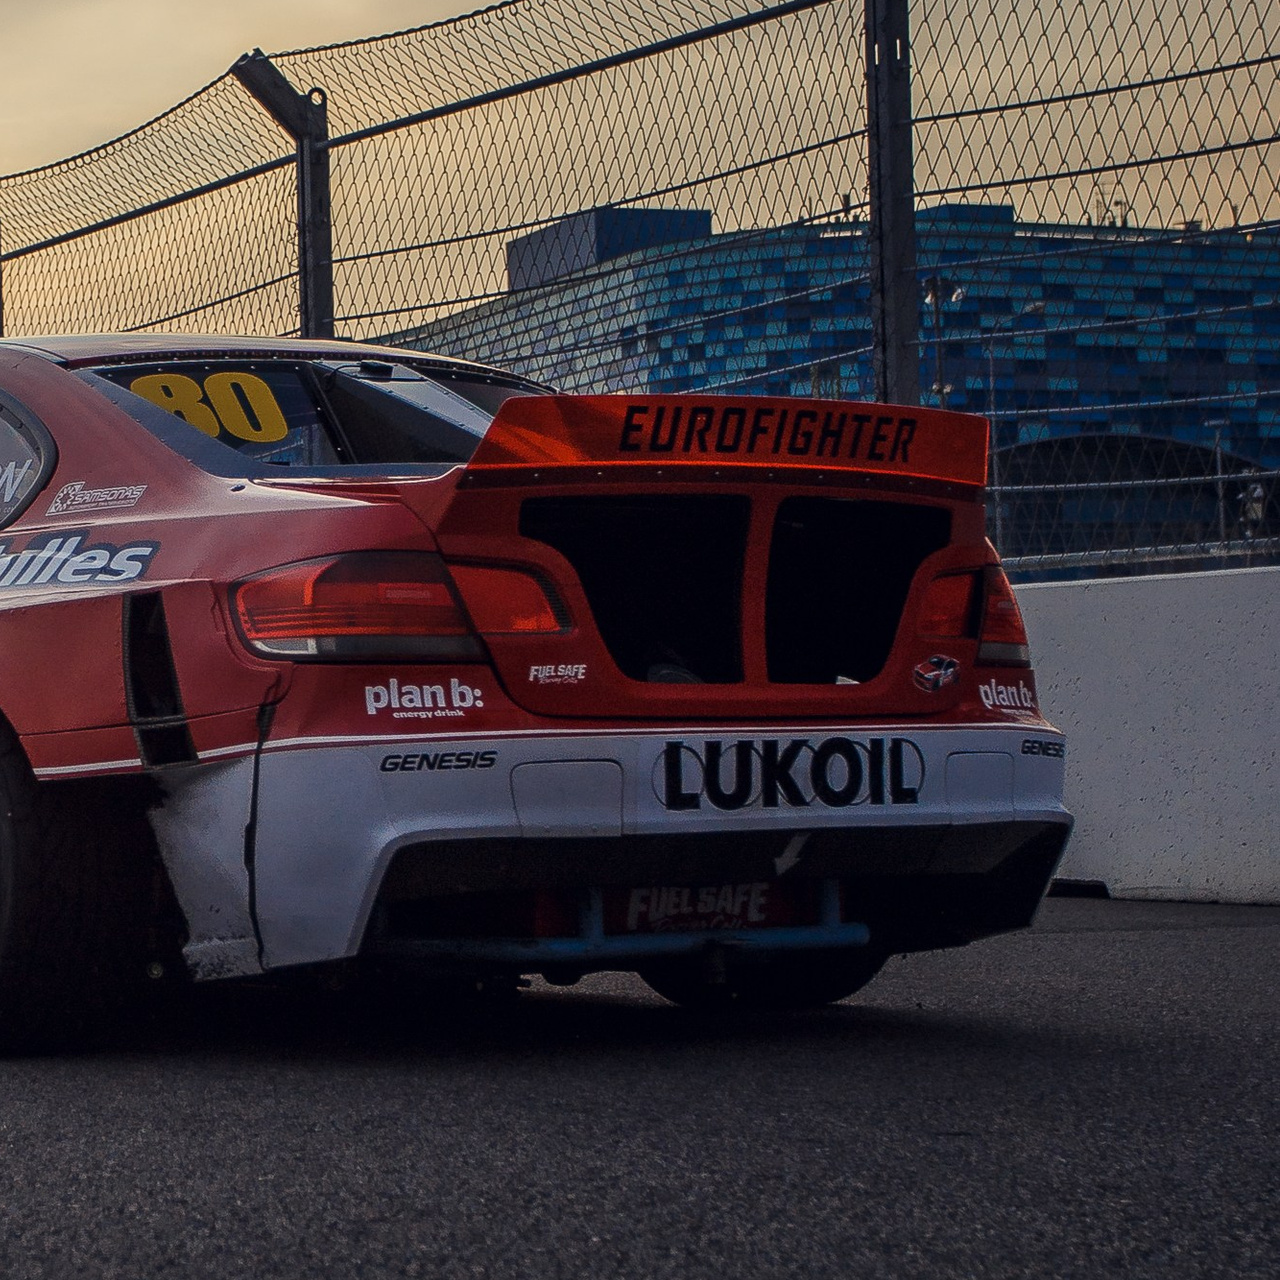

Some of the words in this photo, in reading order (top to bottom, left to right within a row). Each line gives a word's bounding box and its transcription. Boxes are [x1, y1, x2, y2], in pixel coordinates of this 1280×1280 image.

[130, 372, 288, 443] 80
[620, 405, 918, 462] EUROFIGHTER
[528, 665, 557, 682] FUEL
[557, 664, 588, 680] SAFE
[365, 678, 446, 715] plan
[978, 678, 1021, 710] plan
[392, 710, 433, 719] energy
[434, 708, 465, 718] drink
[379, 750, 498, 773] GENESIS
[664, 737, 919, 811] LUKOIL
[627, 885, 694, 930] FUEL
[696, 882, 770, 922] SAFE
